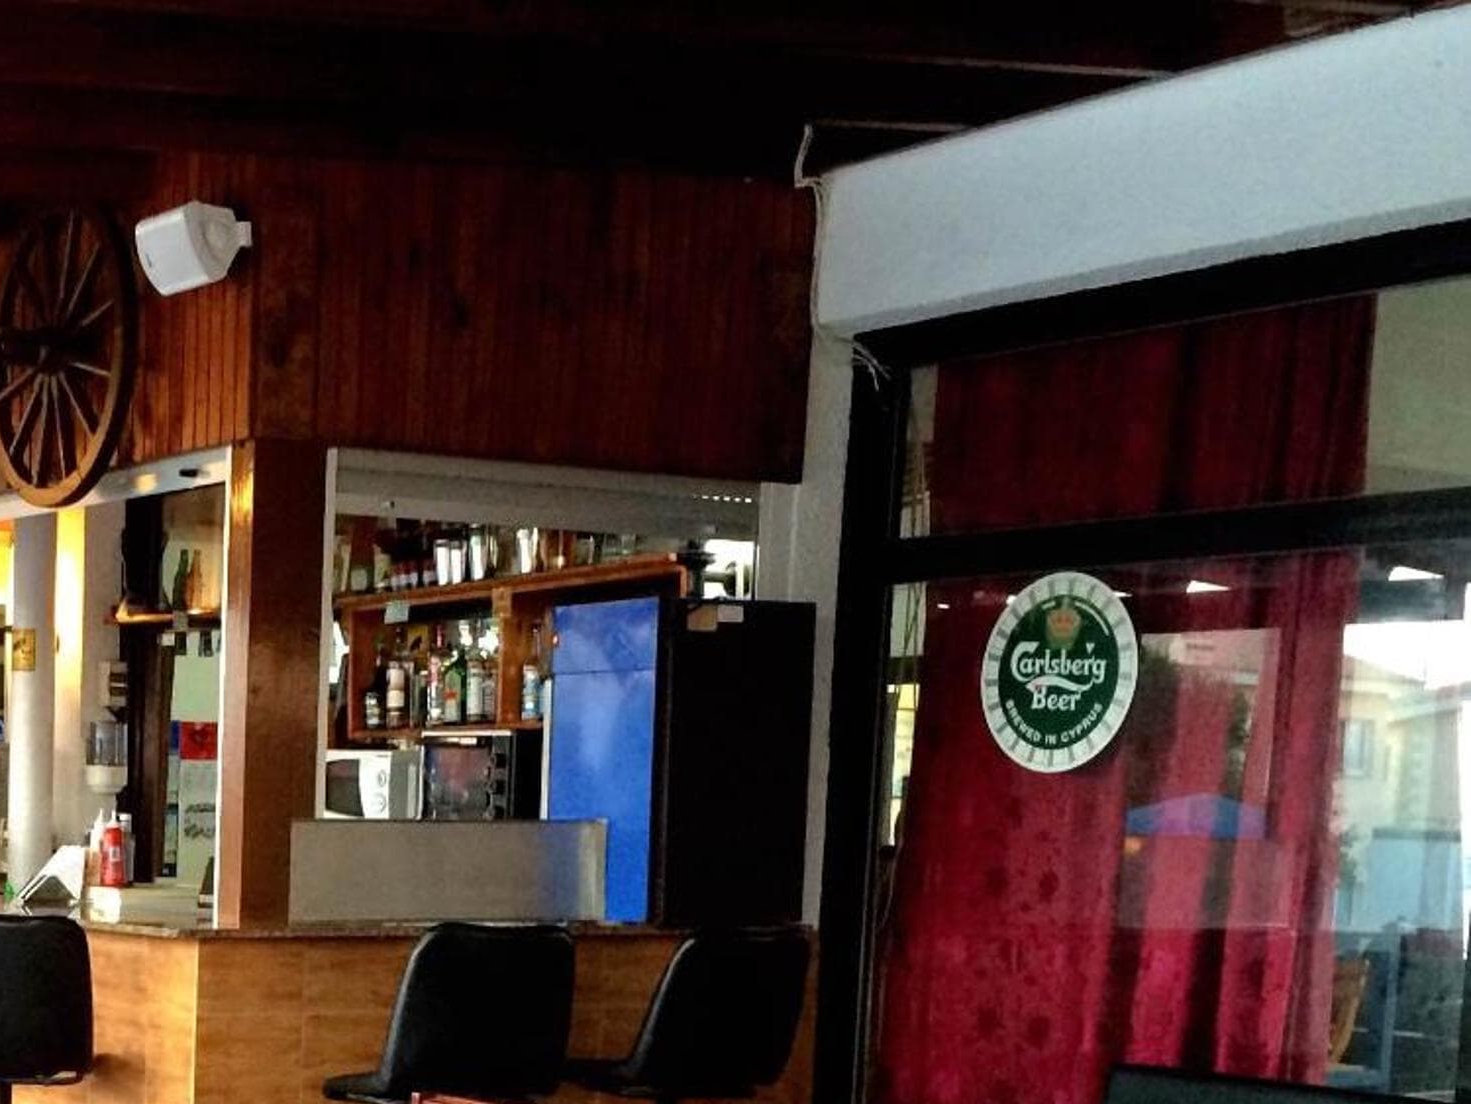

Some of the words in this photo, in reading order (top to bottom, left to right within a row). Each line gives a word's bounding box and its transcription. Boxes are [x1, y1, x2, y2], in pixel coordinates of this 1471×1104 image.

[1010, 640, 1108, 684] Carlsberg
[1031, 685, 1083, 712] Beer
[1005, 699, 1042, 743] BREWED
[1044, 733, 1057, 745] IN
[1060, 702, 1104, 743] CYPRUS
